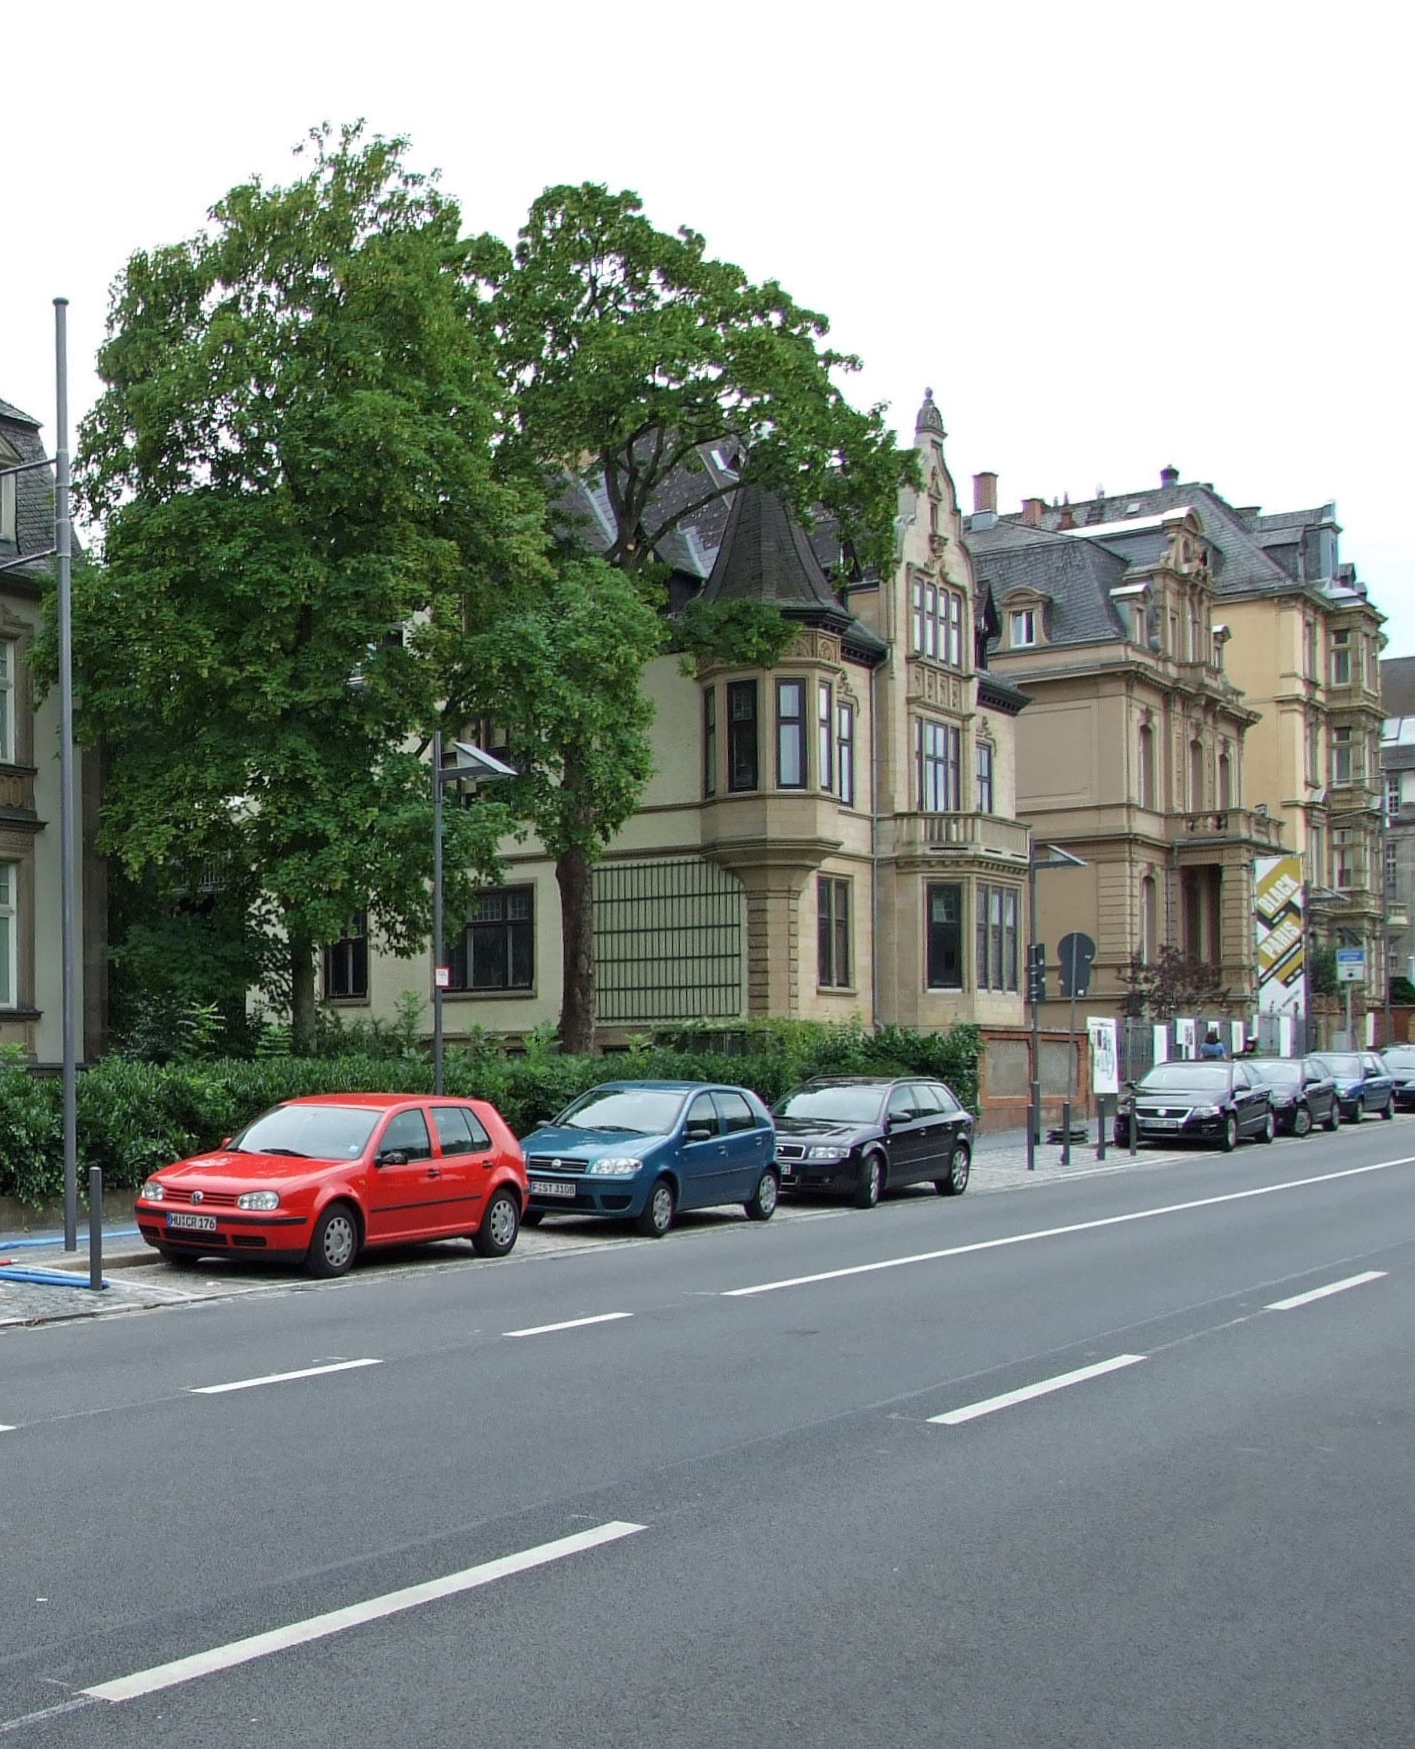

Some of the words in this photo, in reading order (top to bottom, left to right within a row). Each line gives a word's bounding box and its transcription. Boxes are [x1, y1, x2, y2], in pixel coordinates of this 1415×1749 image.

[1257, 873, 1299, 914] BLACK
[1259, 920, 1301, 959] PARIS
[171, 1215, 182, 1226] HU
[186, 1216, 197, 1228] CR
[198, 1218, 215, 1229] 176
